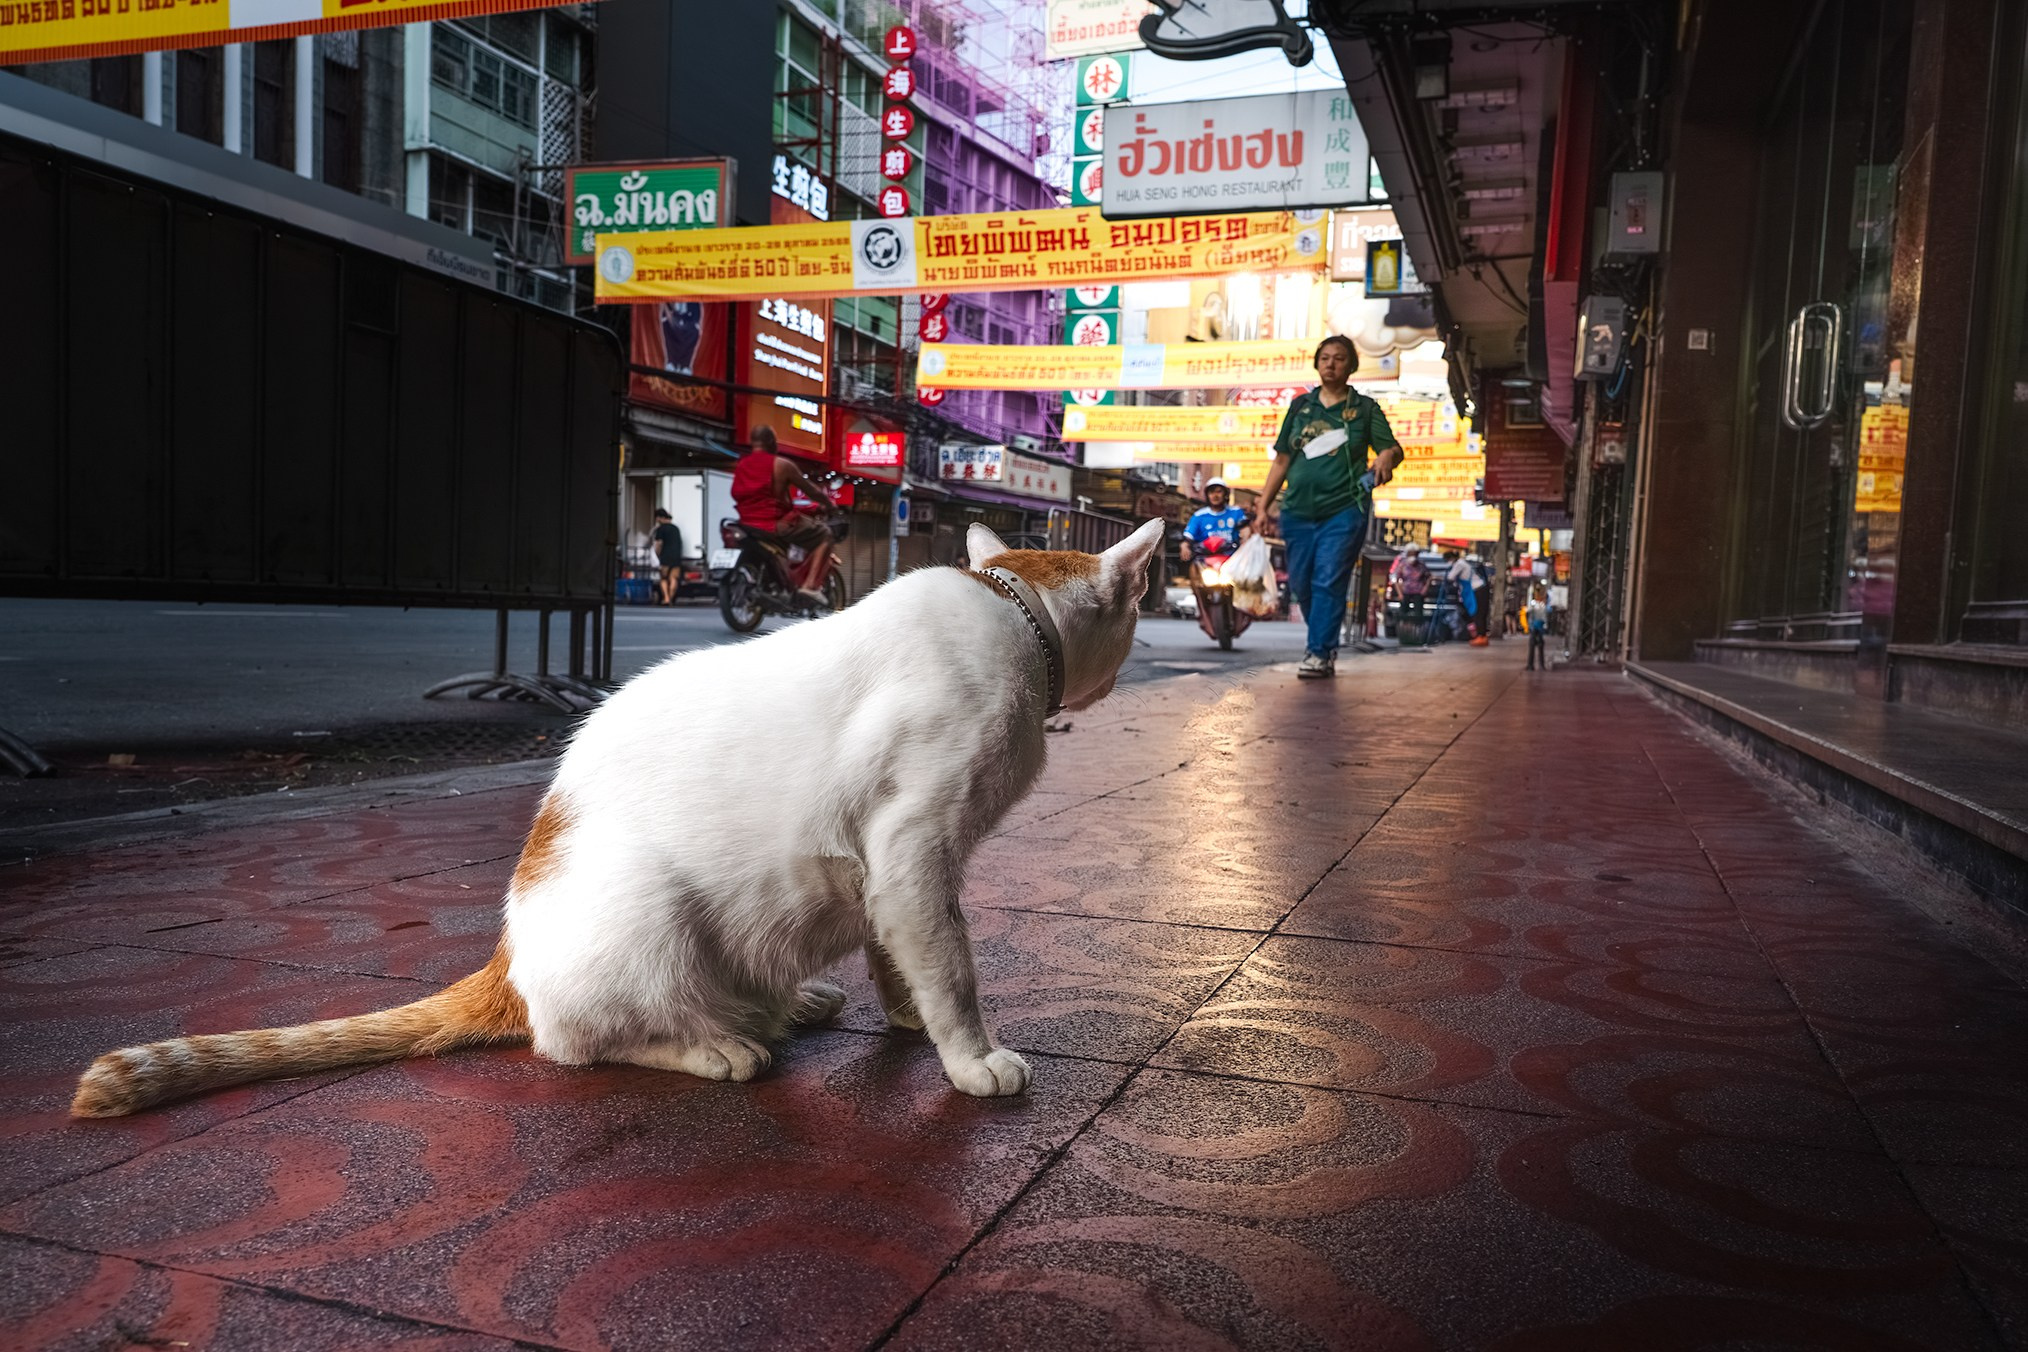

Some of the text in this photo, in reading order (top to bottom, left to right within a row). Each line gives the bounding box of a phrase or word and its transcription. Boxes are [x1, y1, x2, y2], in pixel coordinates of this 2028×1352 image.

[885, 31, 911, 215] 上海生煎包
[1118, 113, 1305, 178] ฮั่วเซ่งฮง
[575, 170, 717, 226] ฉ.มั่นคง
[772, 155, 829, 221] 生煎包
[1116, 179, 1304, 202] HUA SENG HONG RESTAURANT
[1110, 216, 1249, 248] อมปอรต
[754, 258, 775, 277] 50
